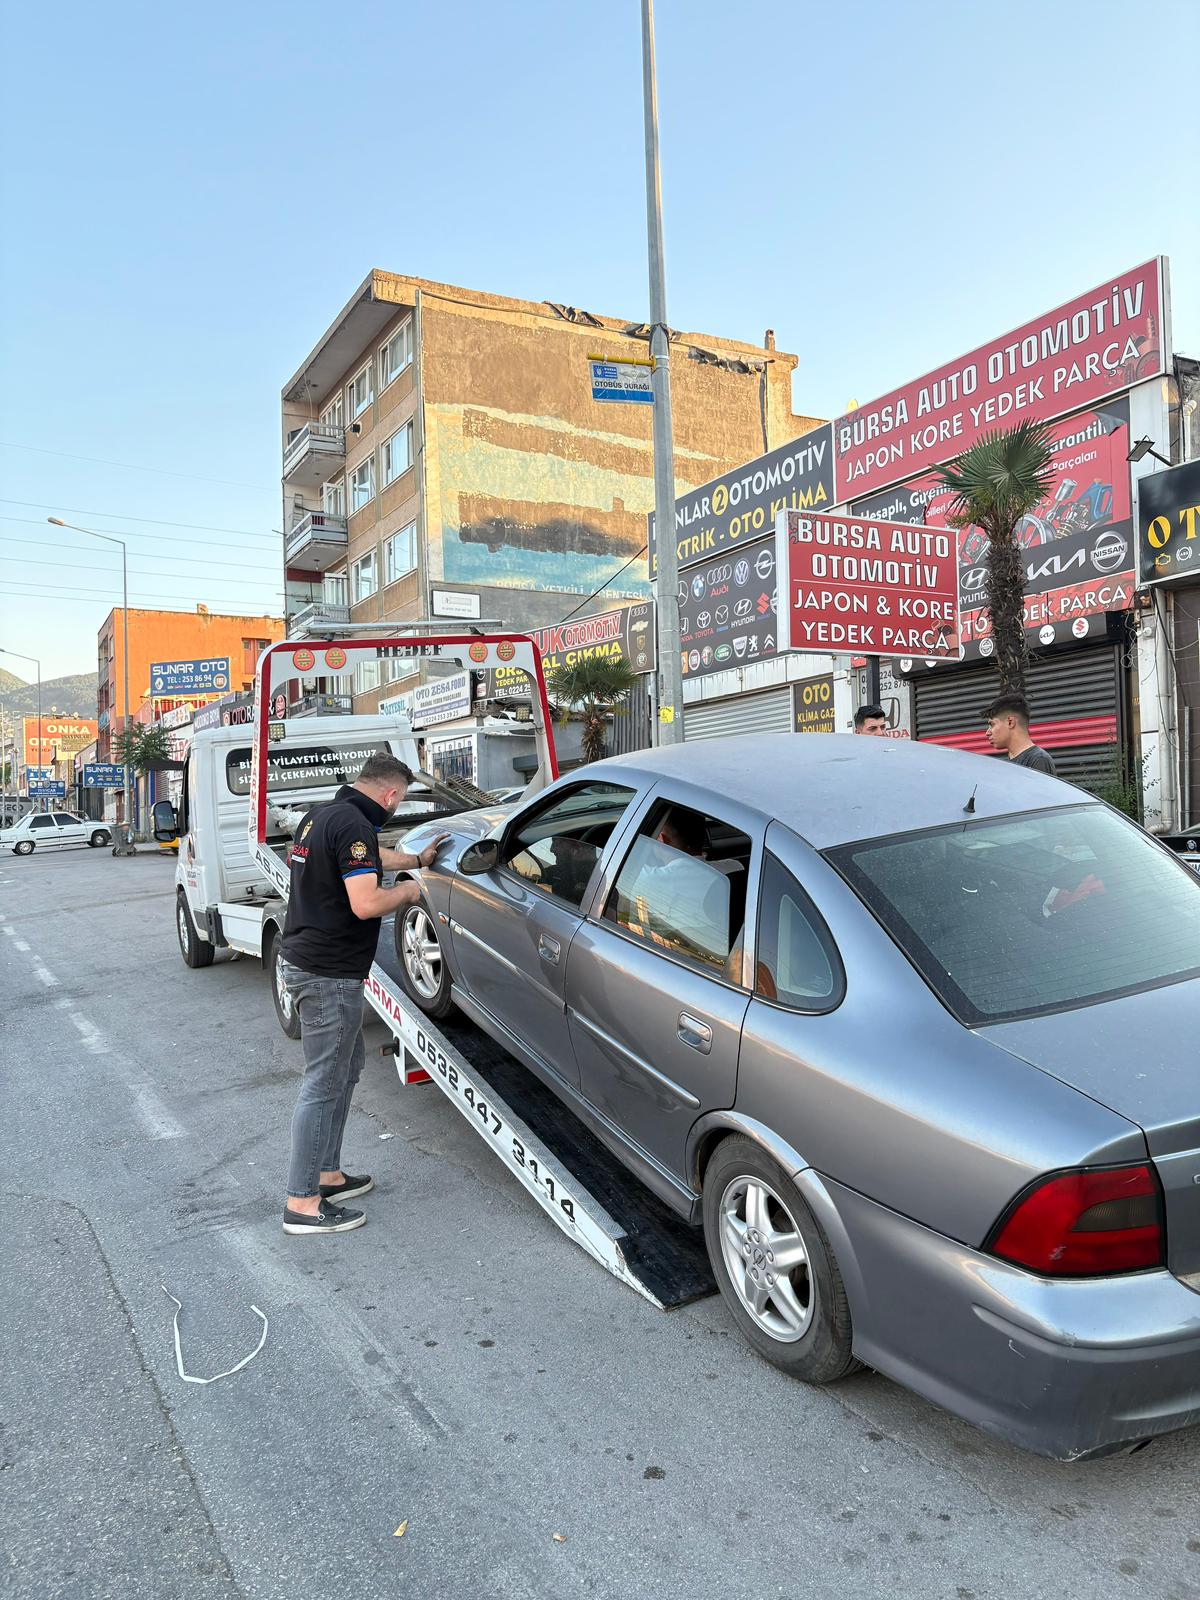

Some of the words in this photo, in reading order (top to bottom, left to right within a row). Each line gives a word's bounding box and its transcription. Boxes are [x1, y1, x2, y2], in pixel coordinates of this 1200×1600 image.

[839, 398, 909, 454] BURSA
[916, 364, 977, 418] AUTO
[987, 281, 1145, 384] OTOMOTİV
[594, 380, 623, 389] OTOBÜS
[846, 438, 904, 483] JAPON
[910, 412, 964, 454] KORE
[969, 375, 1045, 428] YEDEK
[1053, 335, 1142, 394] PARÇA
[1052, 450, 1097, 472] Parçaları
[715, 488, 726, 513] 2
[729, 440, 827, 506] OTOMOTİV
[729, 507, 765, 538] OTO
[770, 480, 828, 523] KLİMA
[797, 518, 881, 551] BURSA
[890, 530, 950, 558] AUTO
[1093, 544, 1125, 559] NISSAN
[811, 552, 938, 589] OTOMOTİV
[793, 588, 868, 614] JAPON
[876, 595, 891, 616] &
[899, 597, 954, 621] KORE
[1060, 584, 1128, 614] PARÇA
[565, 613, 622, 645] OTOMOTİV
[694, 627, 714, 639] TOYOTA
[801, 620, 875, 646] YEDEK
[882, 626, 950, 655] PARÇA
[376, 644, 444, 659] HEDEF
[152, 663, 194, 676] SUNAR
[200, 660, 227, 673] OTO
[182, 675, 193, 683] 253
[194, 674, 203, 682] 86
[203, 673, 212, 682] 94
[415, 687, 430, 701] OTO
[451, 676, 466, 691] FORD
[495, 677, 515, 687] YEDEK
[495, 688, 507, 698] TEL:
[508, 686, 524, 696] 0224
[803, 682, 830, 705] OTO
[797, 708, 819, 724] KLİMA
[46, 724, 90, 735] ONKA
[272, 752, 319, 767] VİLAYETİ
[281, 764, 363, 783] ÇEKEMİYORSUN
[416, 1029, 459, 1092] 0532
[464, 1086, 503, 1136] 447
[512, 1137, 576, 1223] 3114
